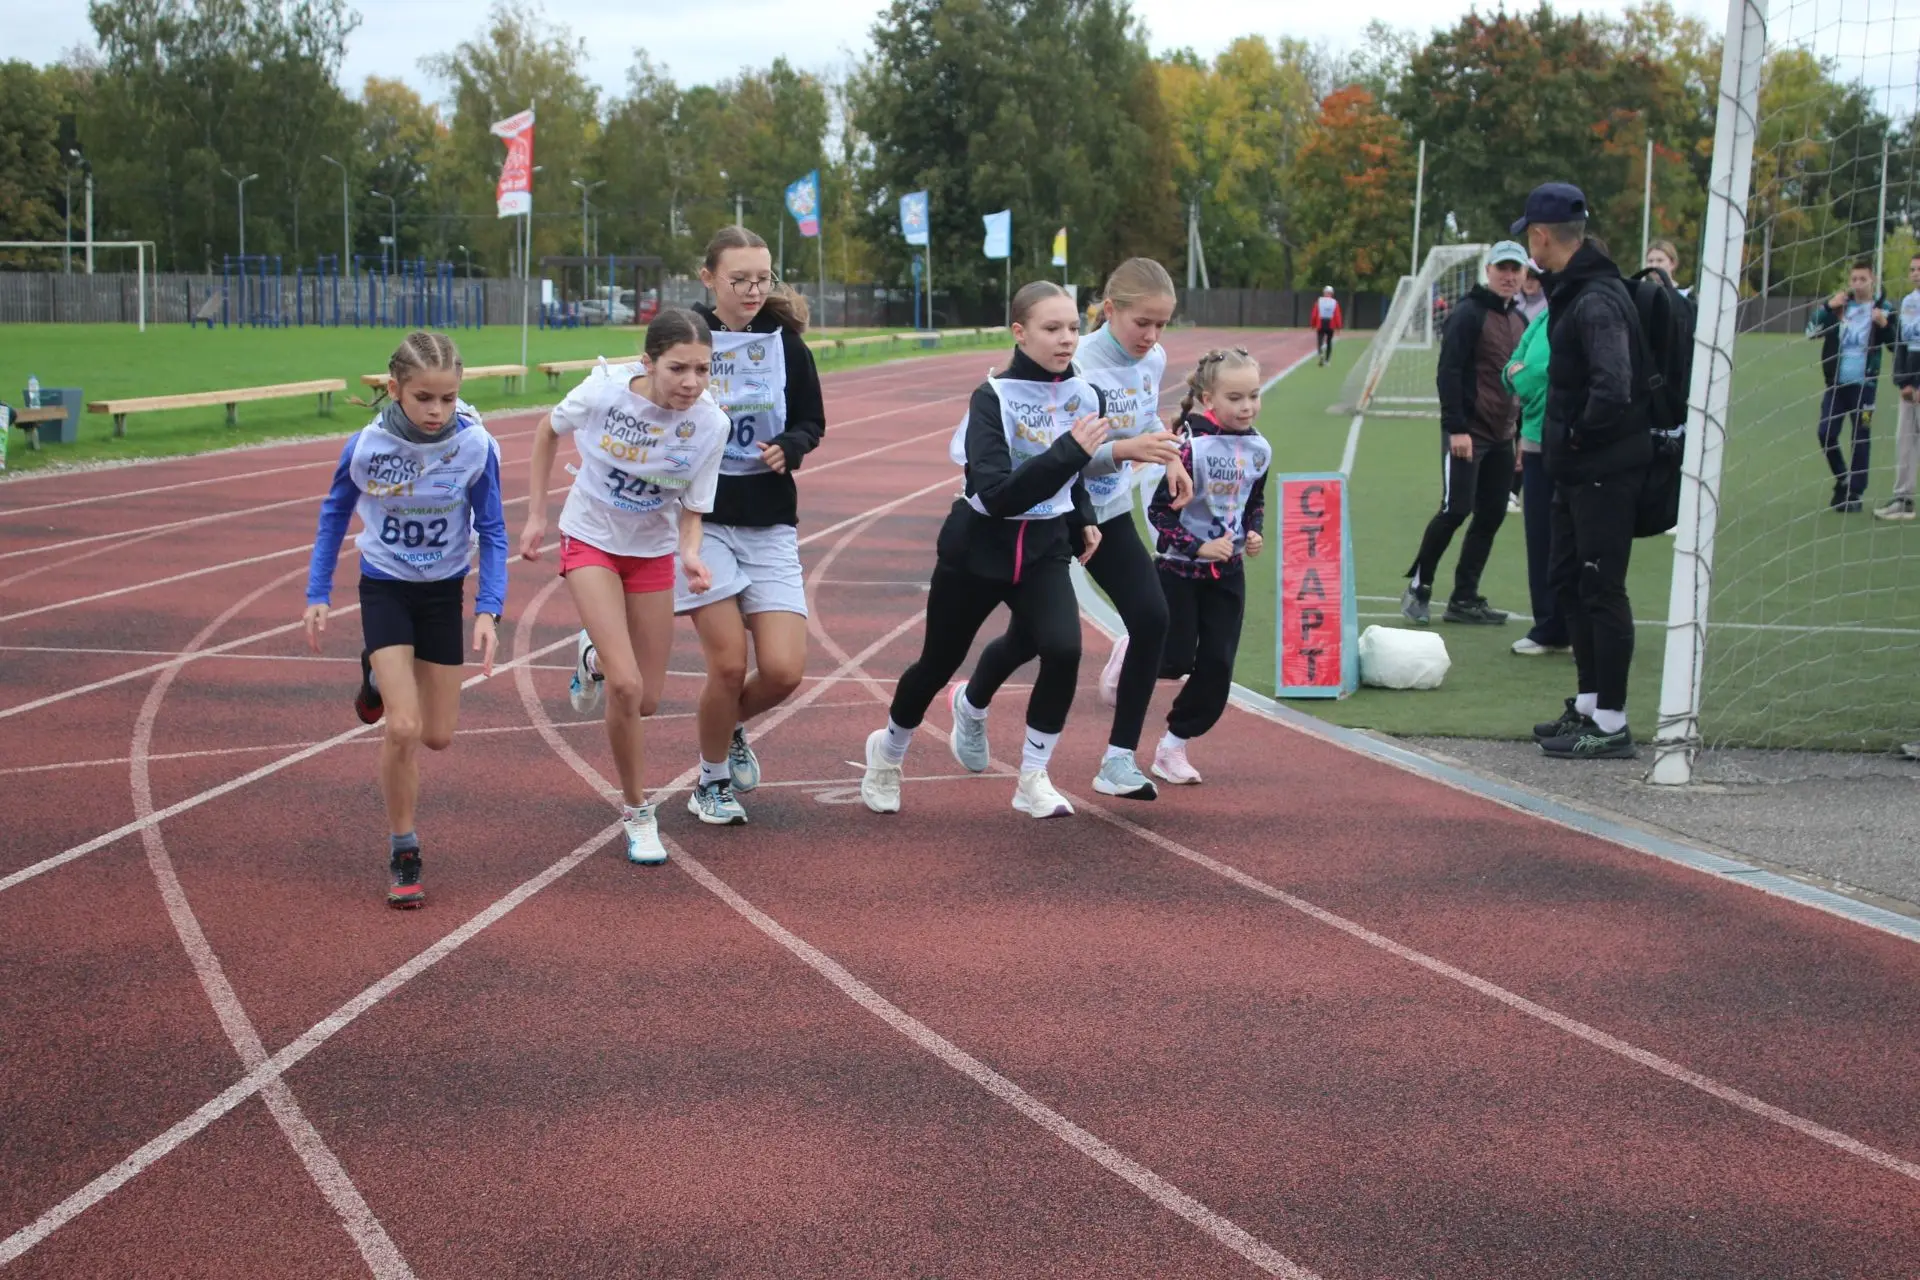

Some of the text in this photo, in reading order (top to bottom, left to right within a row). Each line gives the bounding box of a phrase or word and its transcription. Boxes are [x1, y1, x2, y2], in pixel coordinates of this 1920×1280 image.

[1102, 388, 1126, 400] РОСС
[1107, 399, 1138, 413] АЦИИ
[608, 407, 650, 434] КРОСС
[1020, 415, 1054, 429] АЦИИ
[1108, 413, 1136, 429] 021
[604, 420, 658, 447] НАЦИИ
[599, 435, 649, 464] 2021
[370, 452, 417, 475] КРОСС
[368, 465, 418, 484] НАЦ
[1297, 485, 1325, 681] СТАРТ
